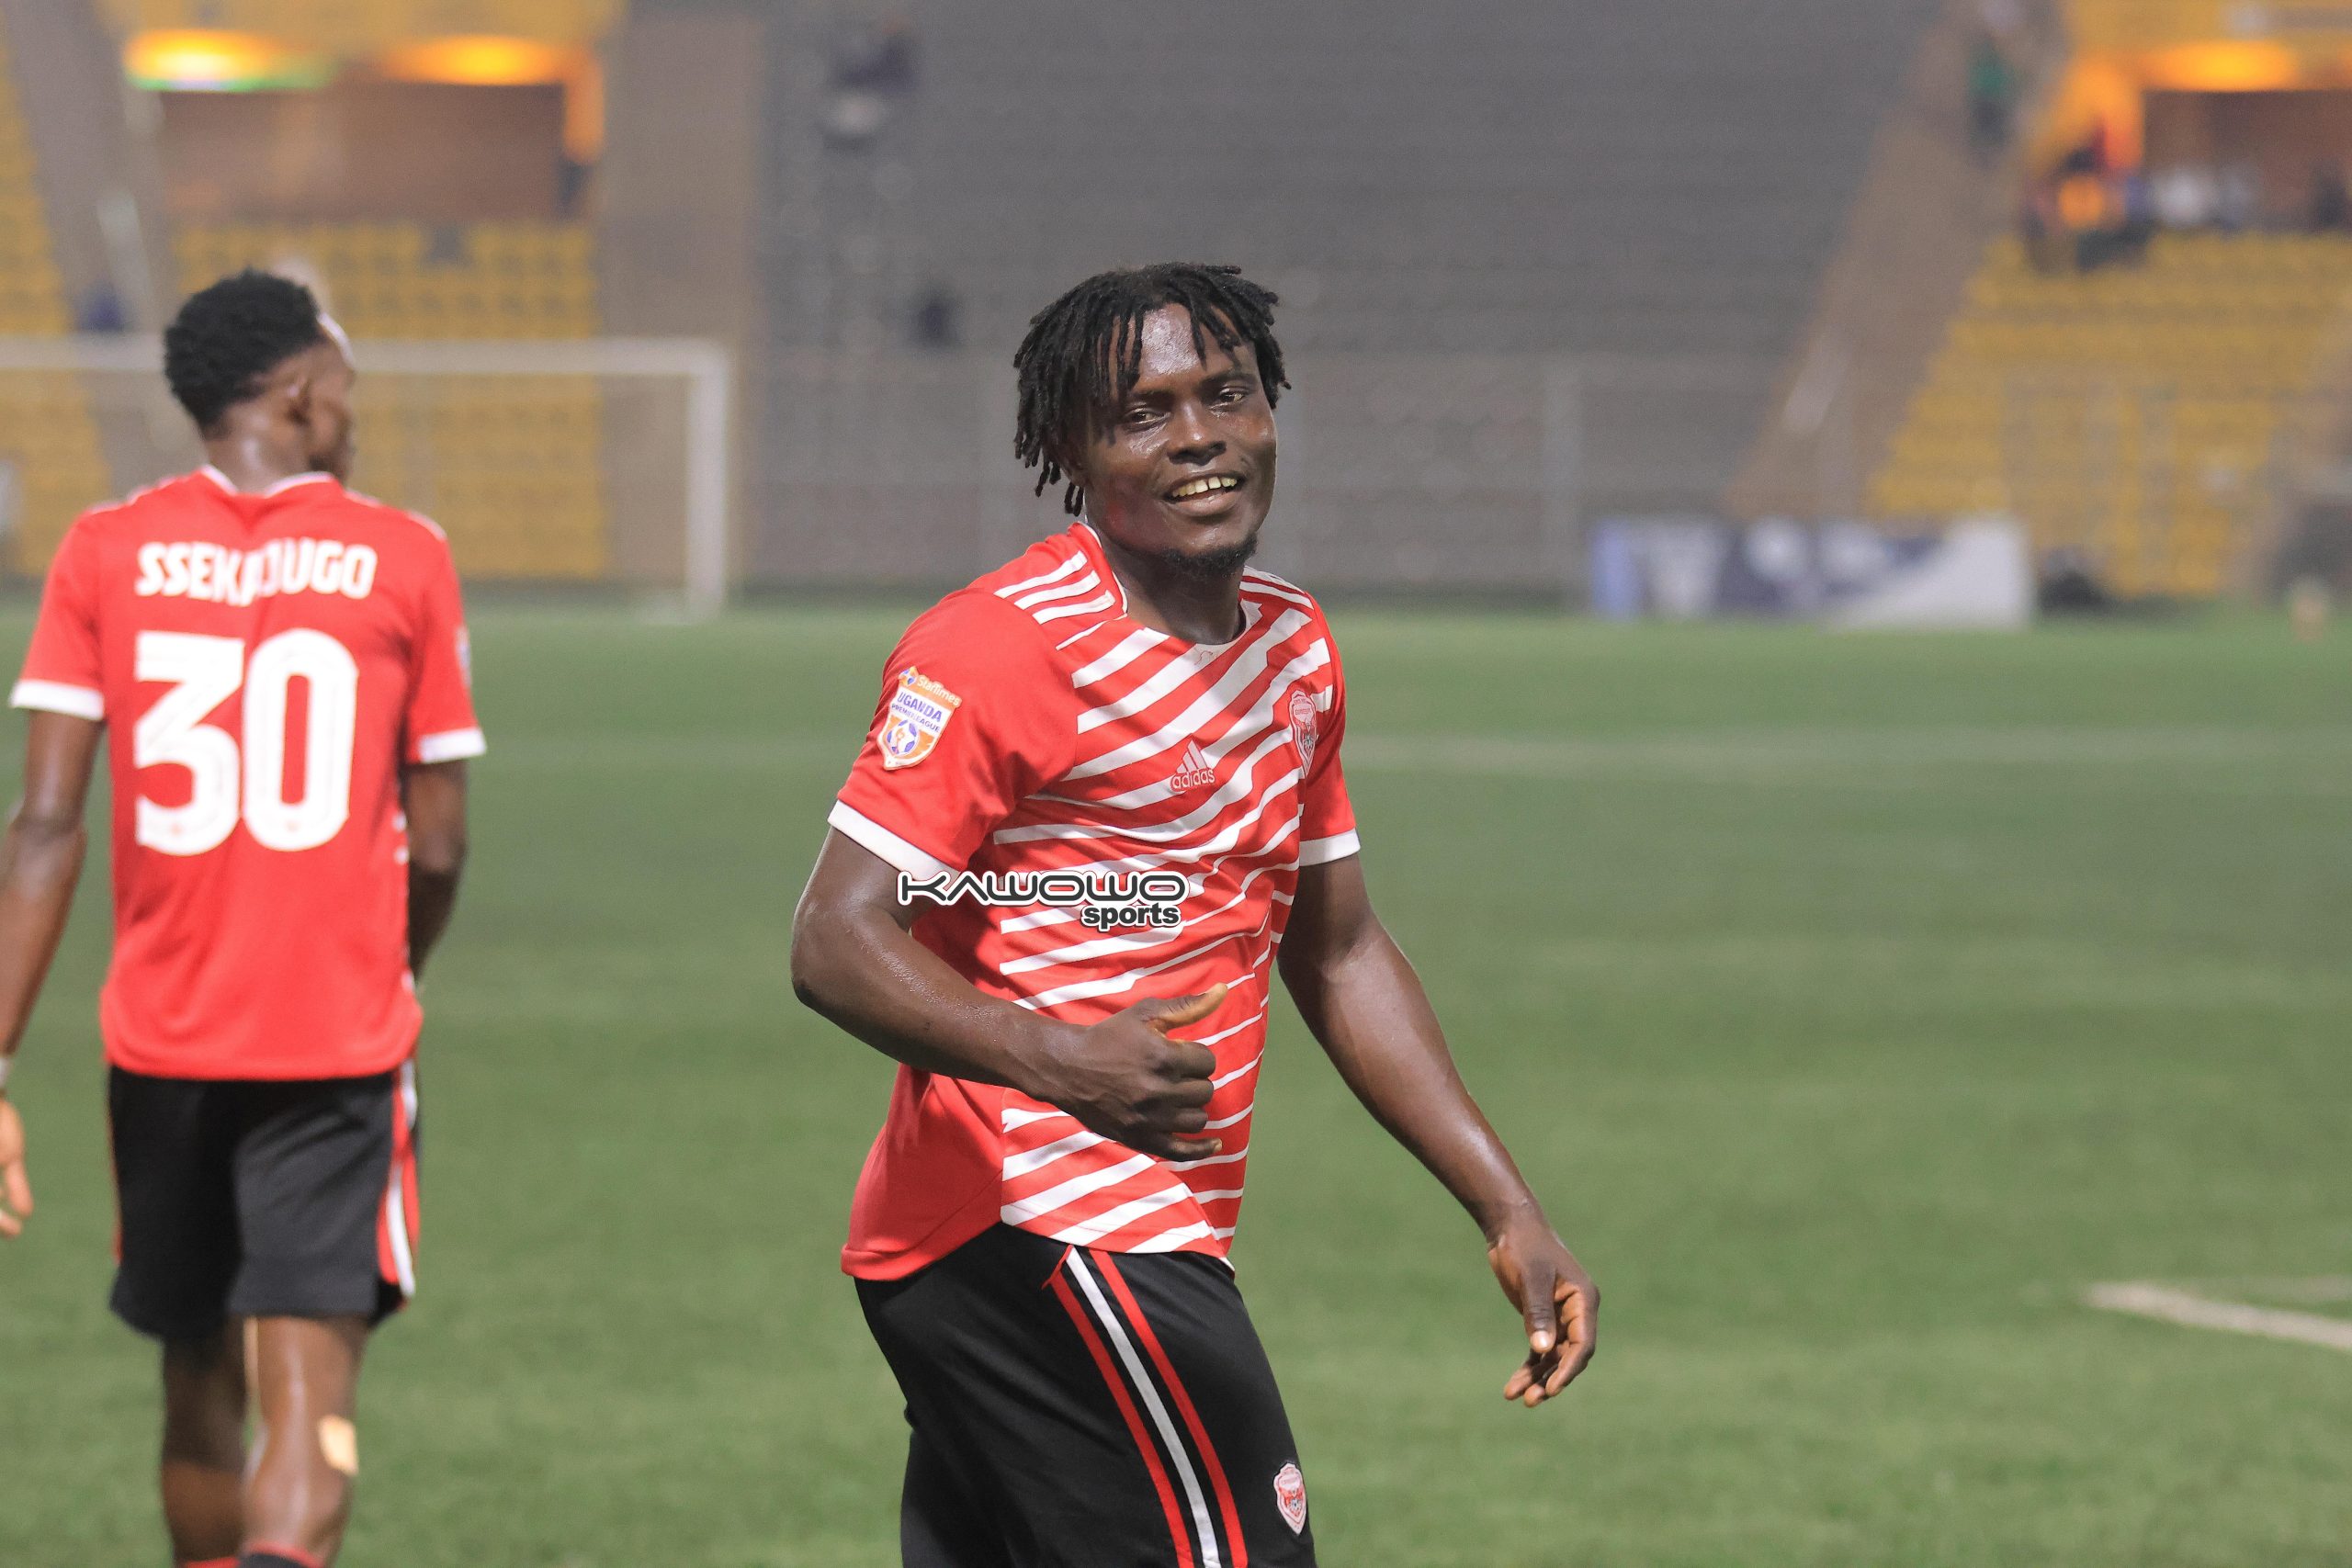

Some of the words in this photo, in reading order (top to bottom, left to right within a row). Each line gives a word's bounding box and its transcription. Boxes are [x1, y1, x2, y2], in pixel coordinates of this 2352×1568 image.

[897, 691, 943, 722] UGANDA
[134, 628, 358, 857] 30
[1170, 768, 1215, 790] adidas
